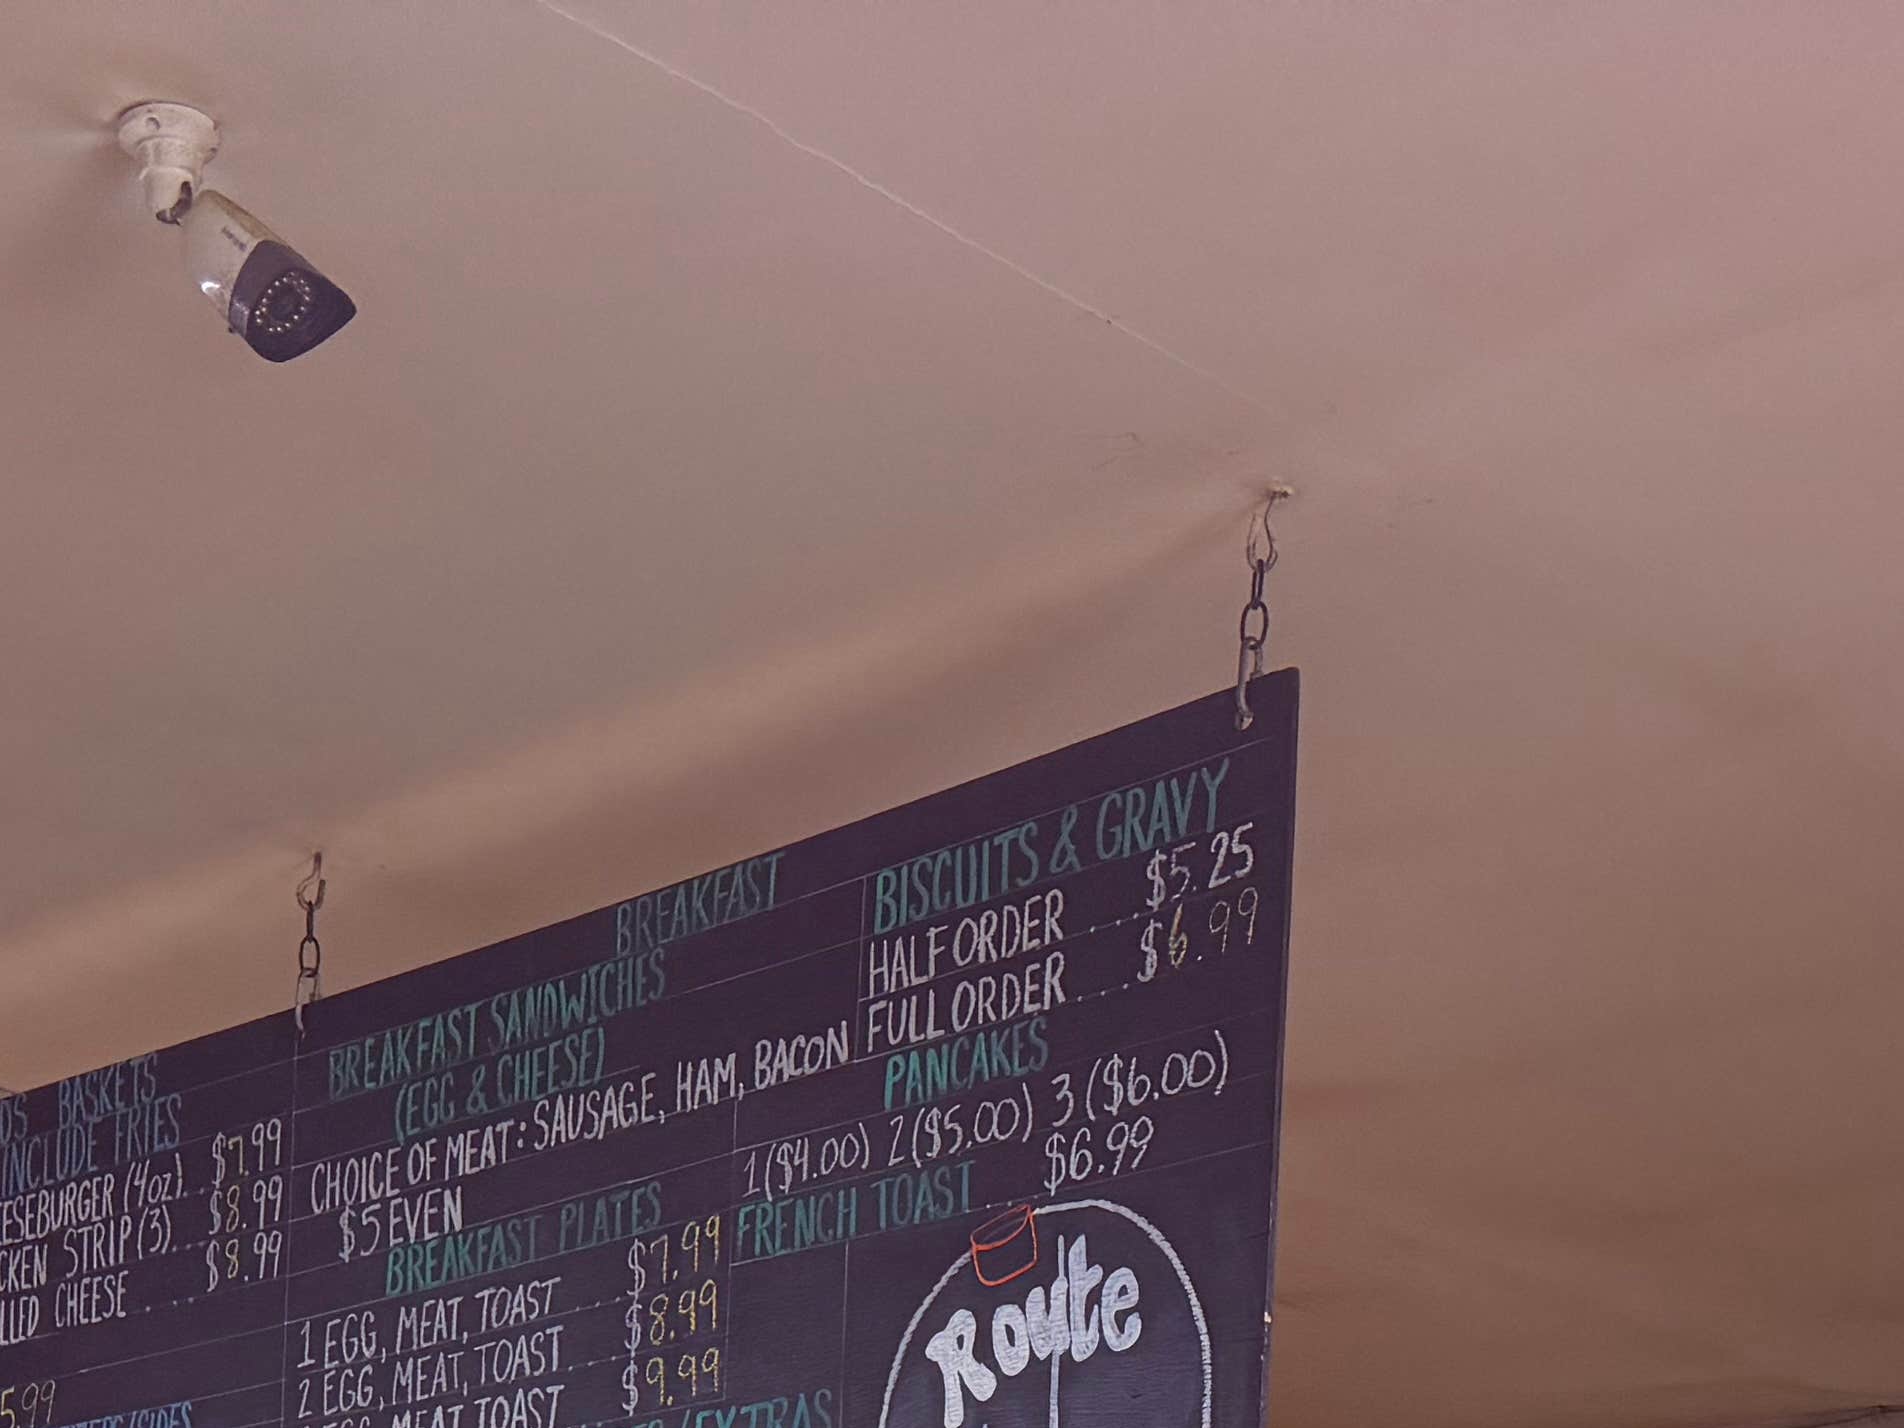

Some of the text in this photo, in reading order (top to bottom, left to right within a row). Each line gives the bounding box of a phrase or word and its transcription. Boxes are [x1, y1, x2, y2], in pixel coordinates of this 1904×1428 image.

[616, 852, 784, 955] BREAKFAST
[874, 758, 1230, 935] BISCUITS & GRAVY
[329, 949, 665, 1098] BREAKFAST SANDWICHES
[885, 1015, 1049, 1110] PANCAKES
[311, 1147, 400, 1215] CHOICE
[408, 1139, 438, 1185] OF
[756, 1034, 849, 1091] BACON
[55, 1270, 129, 1328] CHEESE
[386, 1181, 662, 1299] BREAKFAST PLATES
